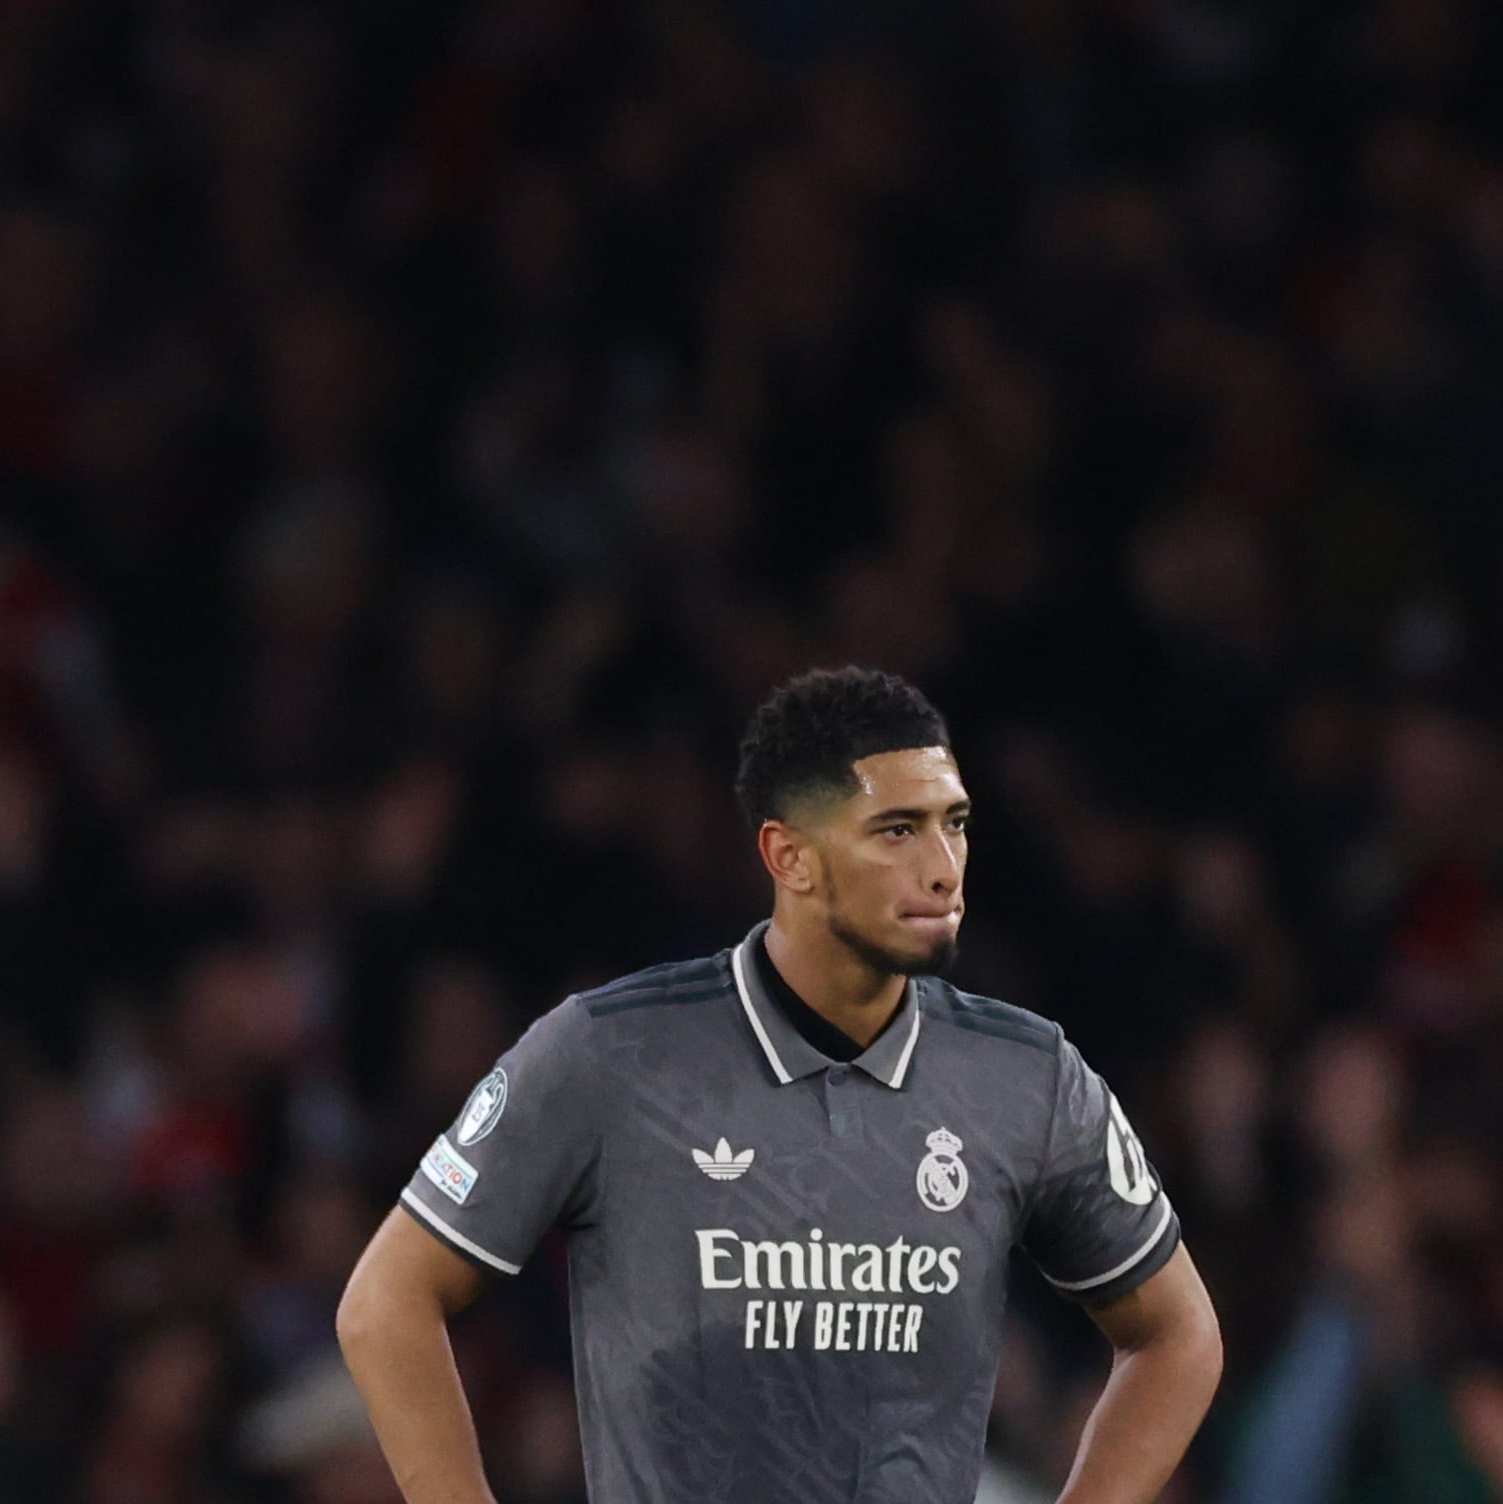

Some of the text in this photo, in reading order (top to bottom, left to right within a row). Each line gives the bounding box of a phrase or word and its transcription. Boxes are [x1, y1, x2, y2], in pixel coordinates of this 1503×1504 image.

[695, 1227, 962, 1294] Emirates
[745, 1300, 923, 1352] FLY BETTER
